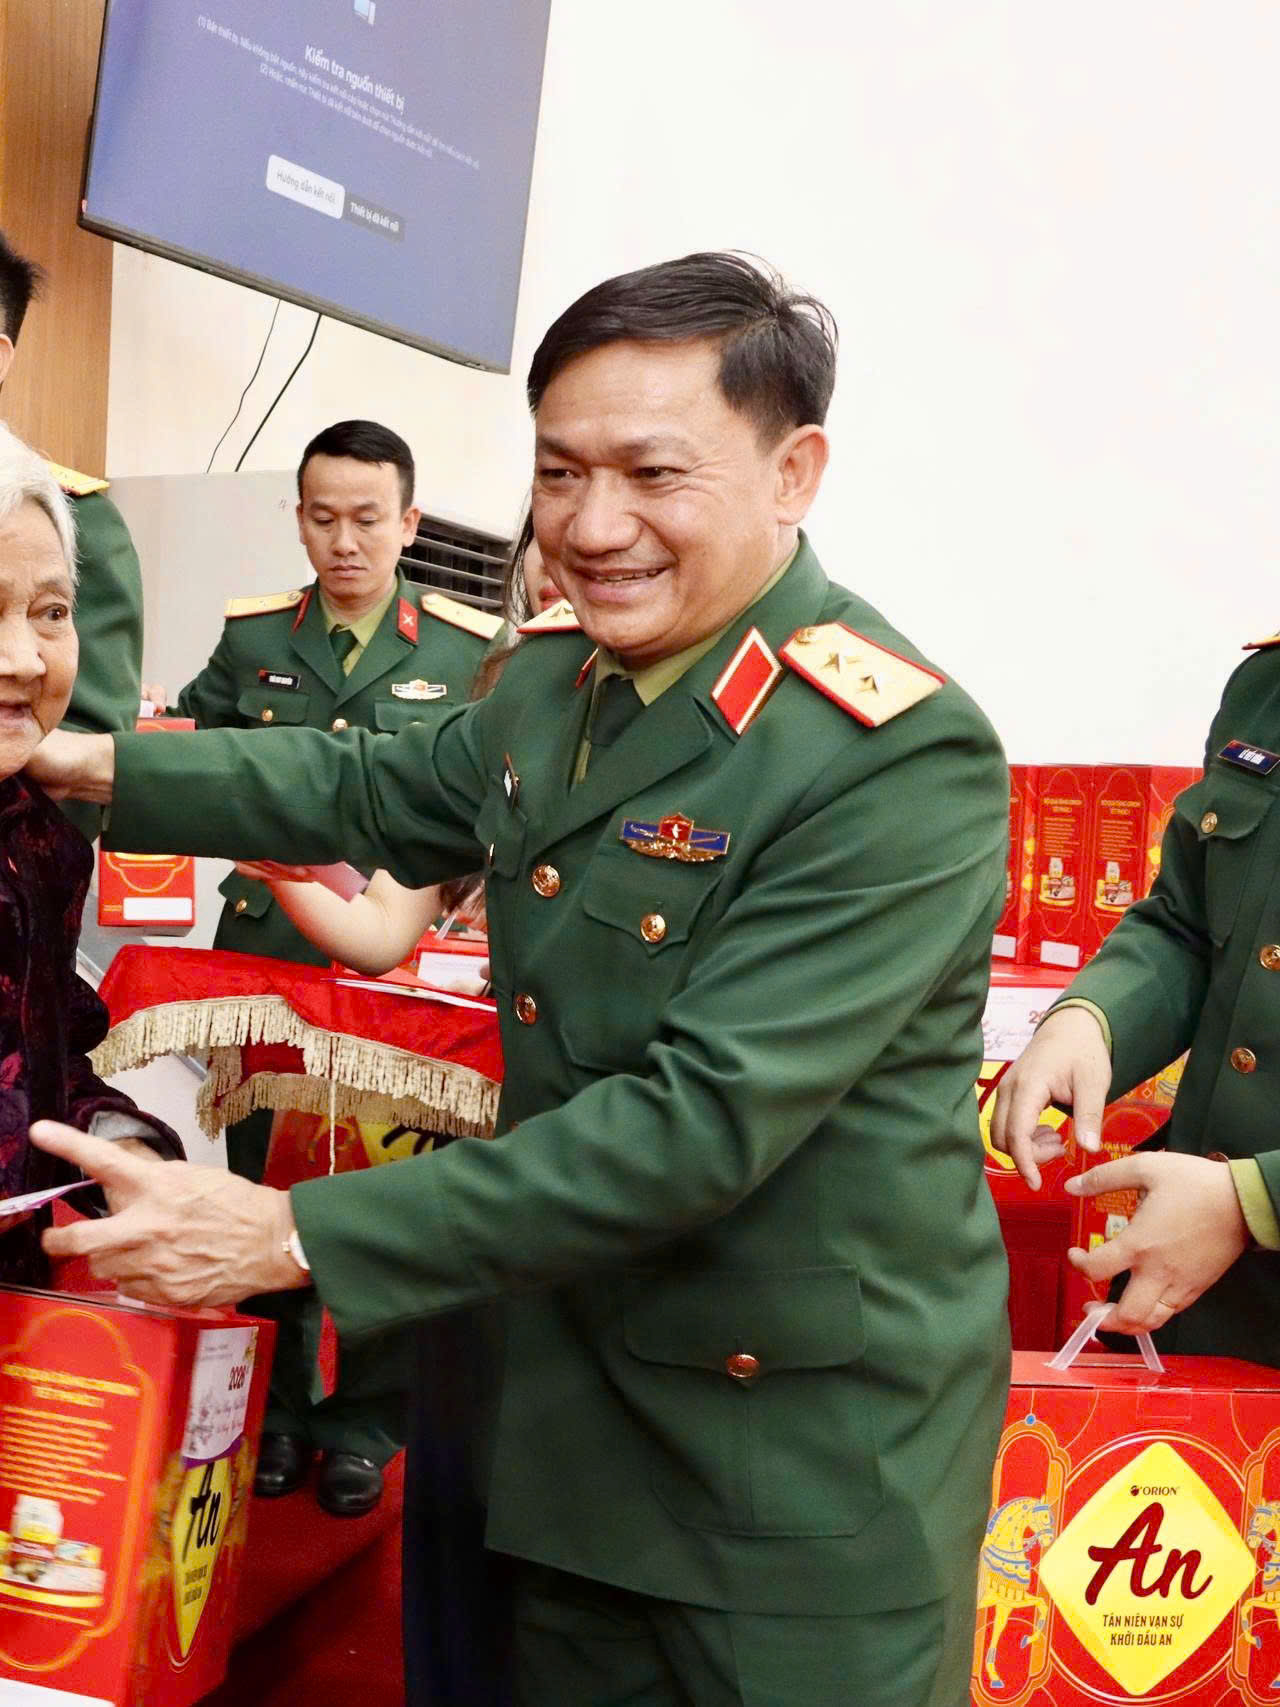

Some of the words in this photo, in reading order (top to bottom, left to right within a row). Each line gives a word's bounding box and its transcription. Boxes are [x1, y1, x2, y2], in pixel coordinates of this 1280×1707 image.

[304, 45, 330, 71] Kiểm
[331, 59, 345, 79] tra
[346, 68, 374, 95] nguồn
[374, 83, 395, 107] thiết
[395, 93, 405, 116] bị
[1142, 1485, 1177, 1496] ORION
[1085, 1502, 1213, 1605] An
[1103, 1612, 1122, 1627] TÂN
[1124, 1612, 1147, 1627] NIÊN
[1149, 1615, 1168, 1629] VẠN
[1170, 1613, 1185, 1629] SỰ
[1110, 1630, 1135, 1646] KHỞI
[1159, 1633, 1173, 1646] AN
